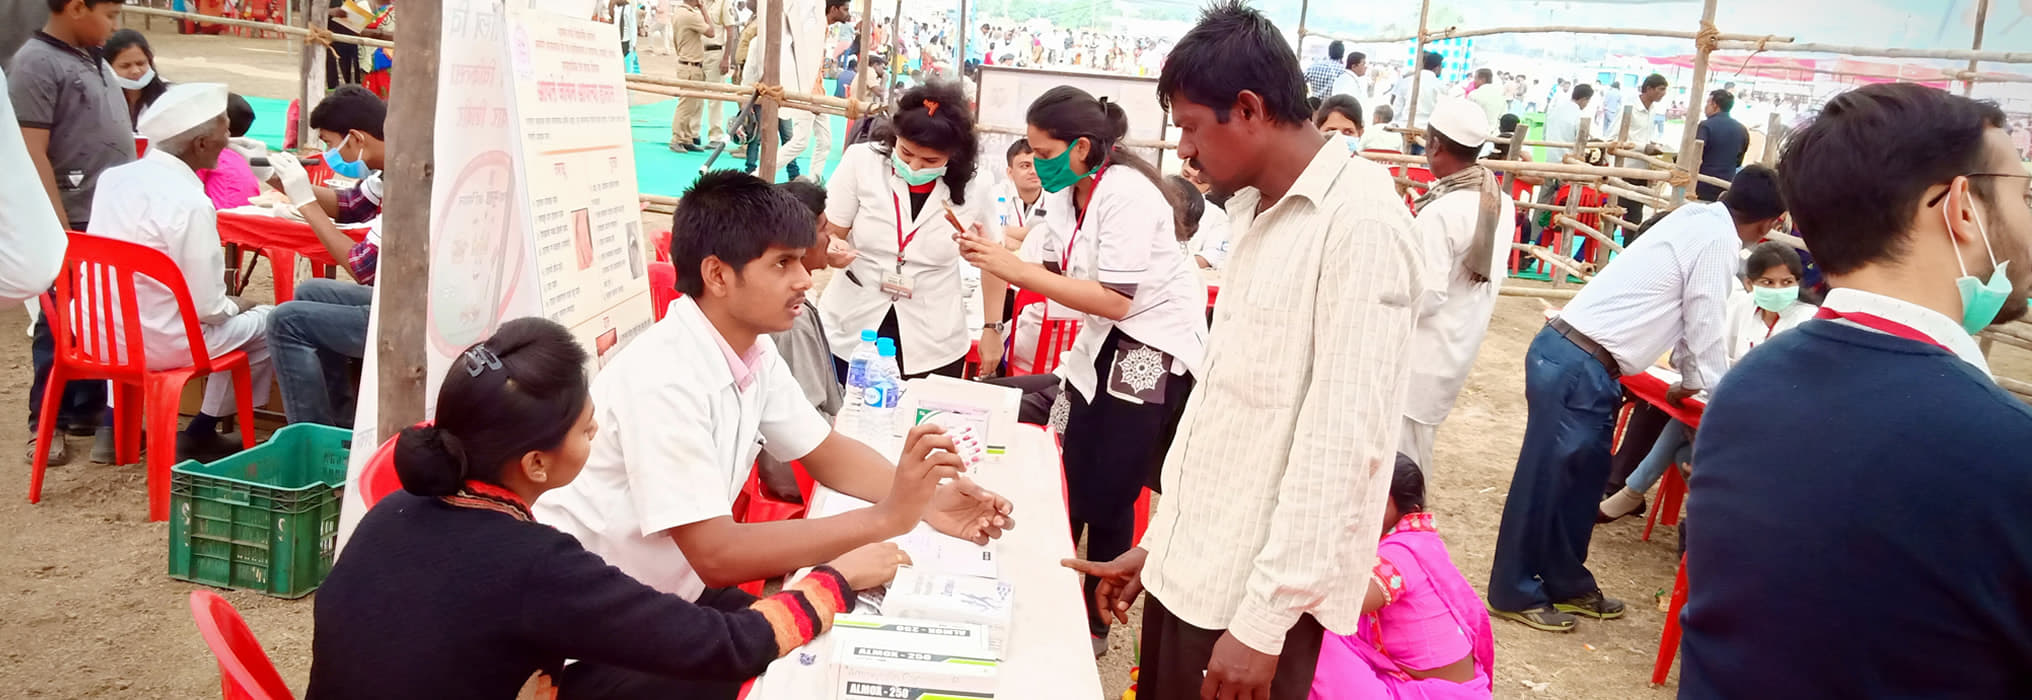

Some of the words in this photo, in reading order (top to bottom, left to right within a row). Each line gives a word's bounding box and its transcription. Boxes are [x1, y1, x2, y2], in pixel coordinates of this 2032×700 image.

[858, 647, 899, 658] ALMOX
[850, 683, 883, 697] ALMOX
[889, 687, 910, 699] 250
